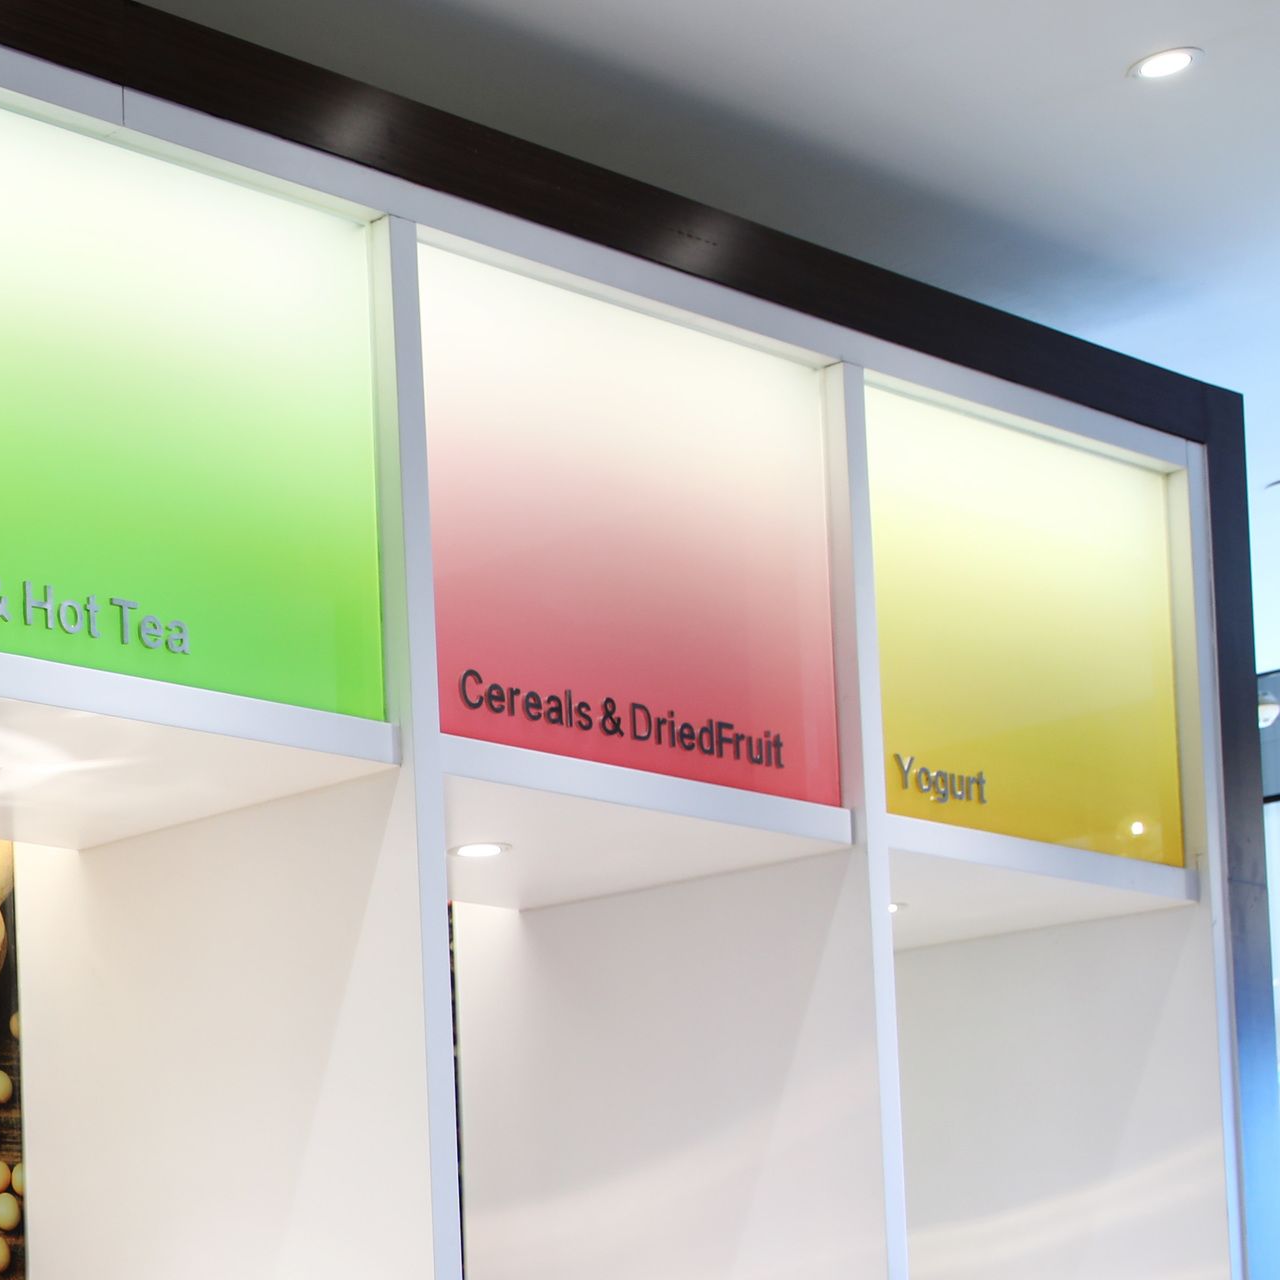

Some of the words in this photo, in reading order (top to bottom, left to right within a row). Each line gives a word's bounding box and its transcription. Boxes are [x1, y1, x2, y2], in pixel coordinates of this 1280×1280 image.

[22, 580, 100, 639] Hot
[109, 597, 190, 655] Tea
[458, 669, 593, 732] Cereals
[600, 697, 624, 737] &
[893, 753, 987, 804] Yogurt
